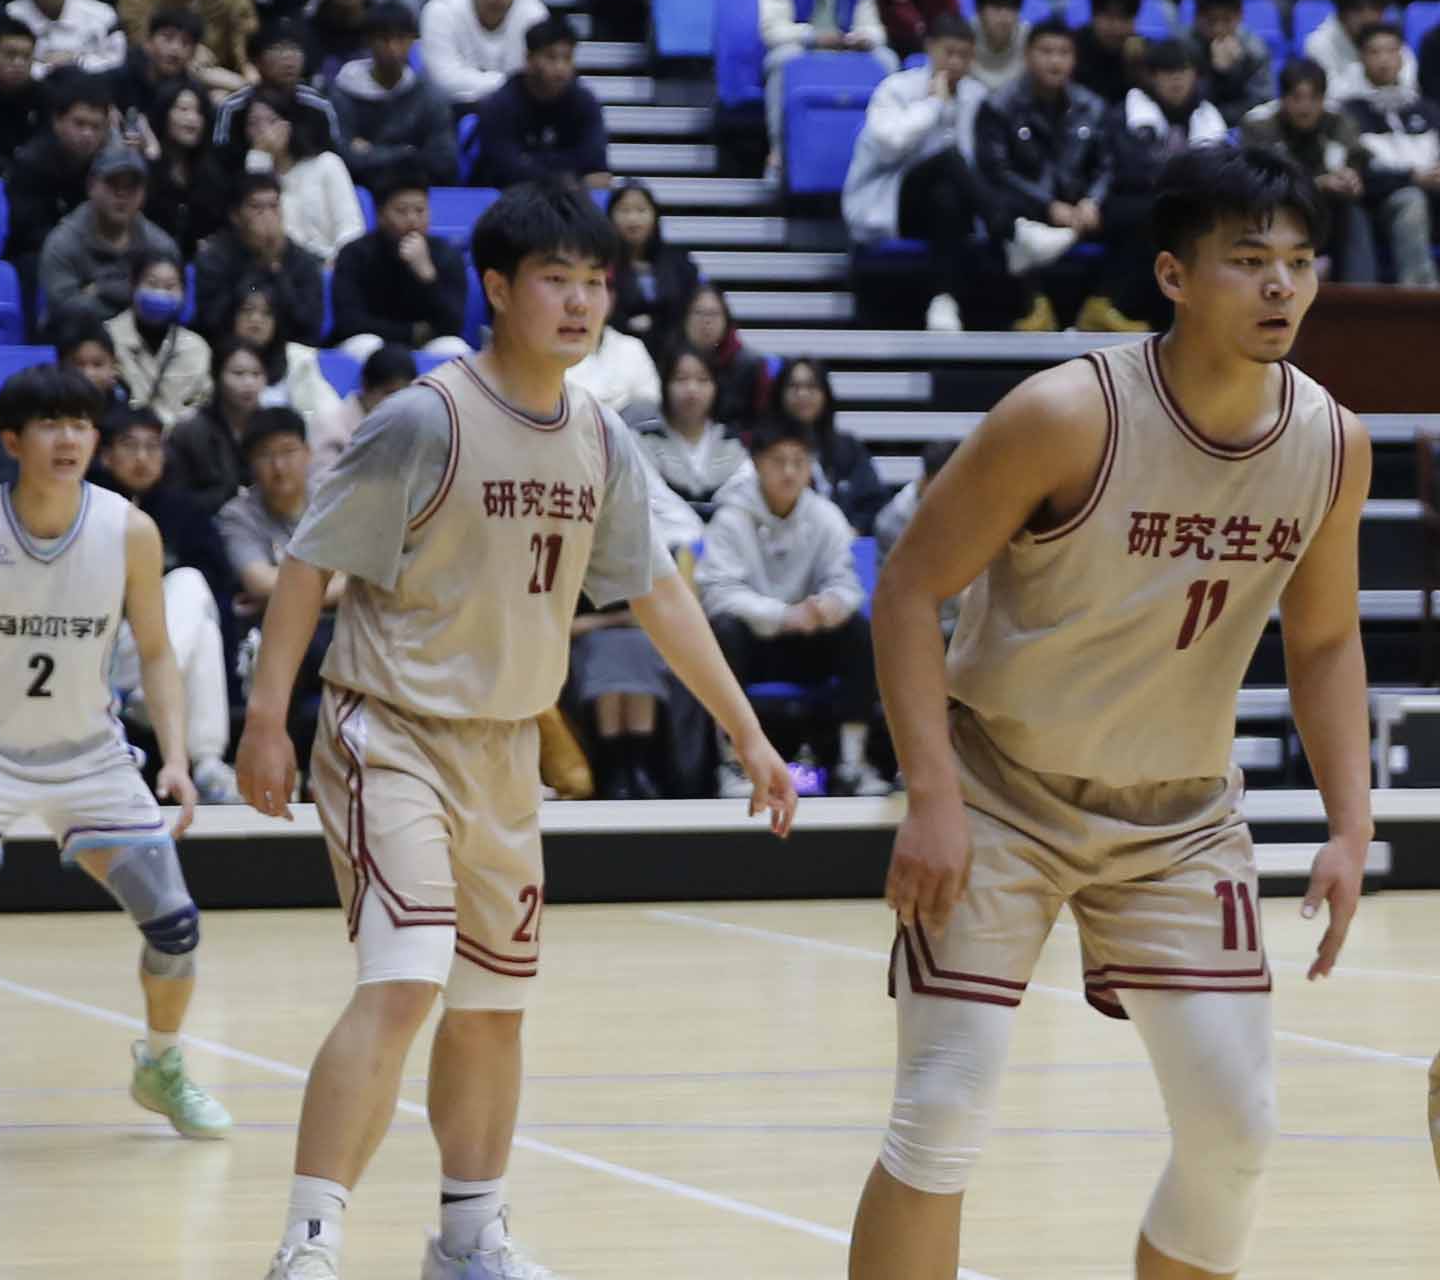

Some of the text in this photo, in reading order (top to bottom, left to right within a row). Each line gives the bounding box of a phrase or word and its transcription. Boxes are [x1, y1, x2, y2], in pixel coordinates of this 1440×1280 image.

[482, 477, 596, 523] 研究生处
[1127, 510, 1302, 563] 研究生处
[1175, 578, 1230, 651] 11
[26, 652, 56, 698] 2
[1215, 879, 1257, 951] 11
